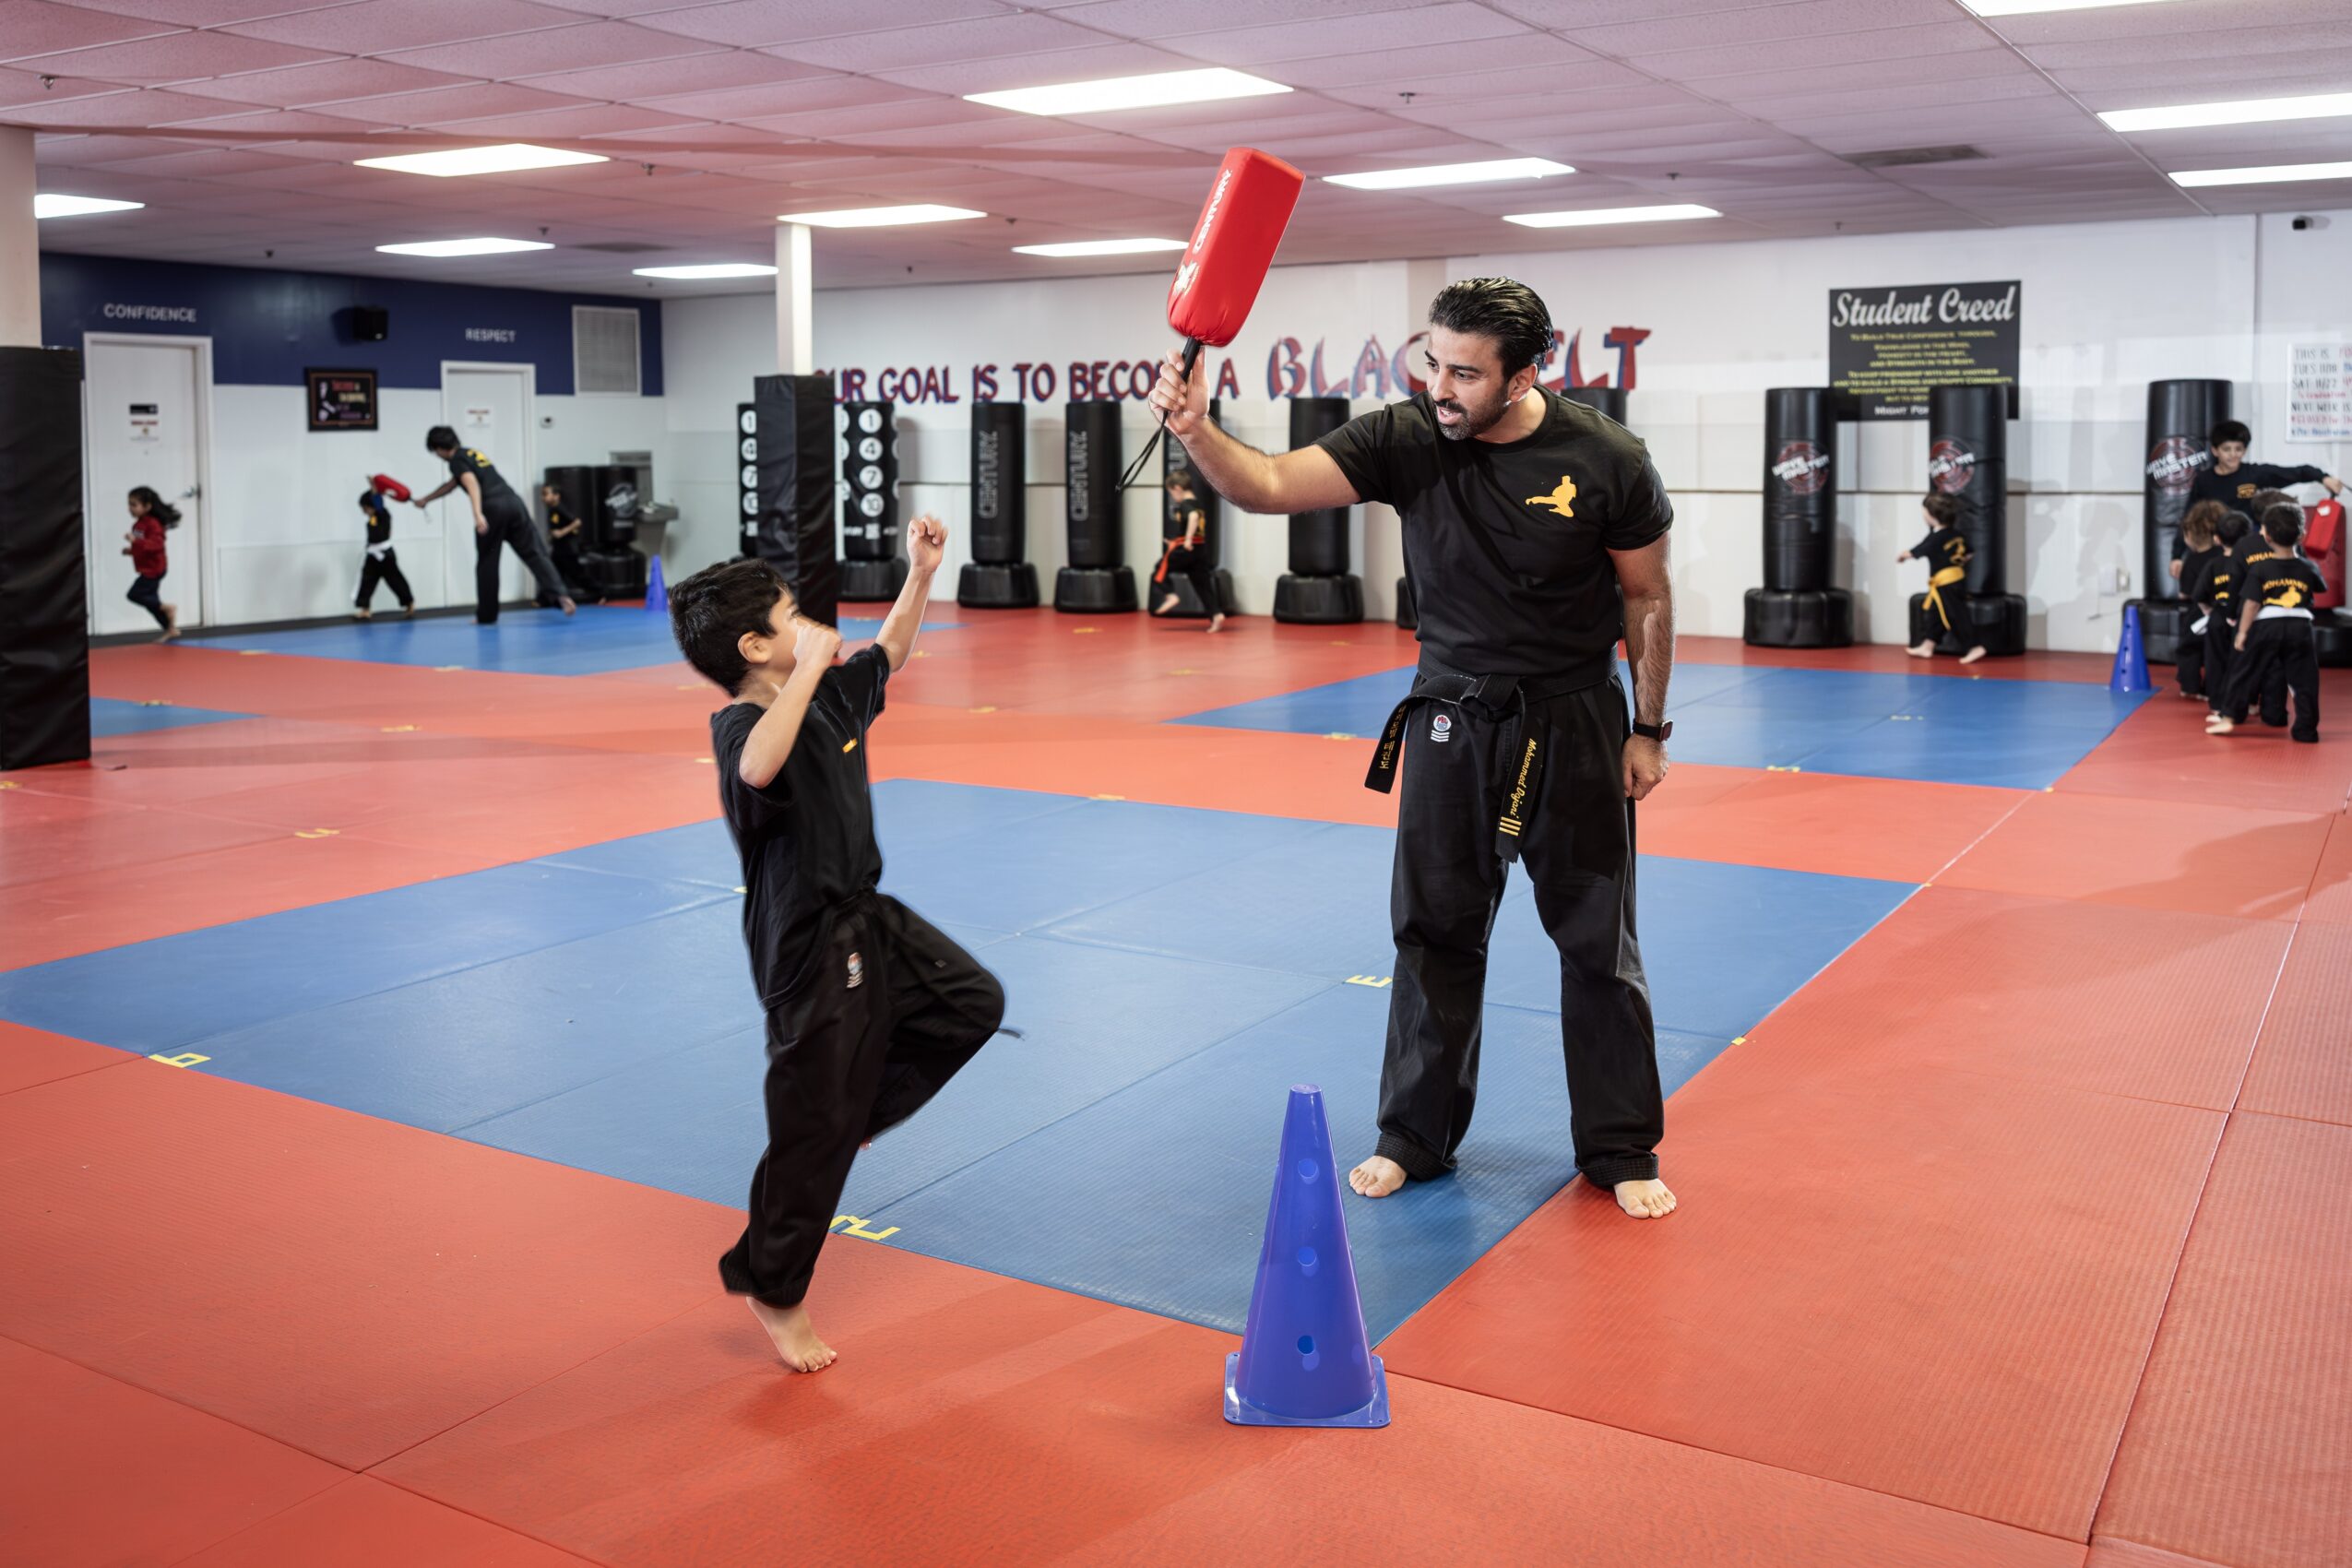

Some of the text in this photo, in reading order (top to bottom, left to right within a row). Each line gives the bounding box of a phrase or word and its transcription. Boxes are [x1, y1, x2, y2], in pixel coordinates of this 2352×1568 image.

[103, 303, 196, 322] CONFIDENCE
[1832, 285, 2016, 327] Student Creed
[465, 328, 516, 342] RESPECT
[814, 327, 1651, 404] UR GOAL IS TO BECO A BLAC ELT
[1517, 738, 1537, 789] Mohammed
